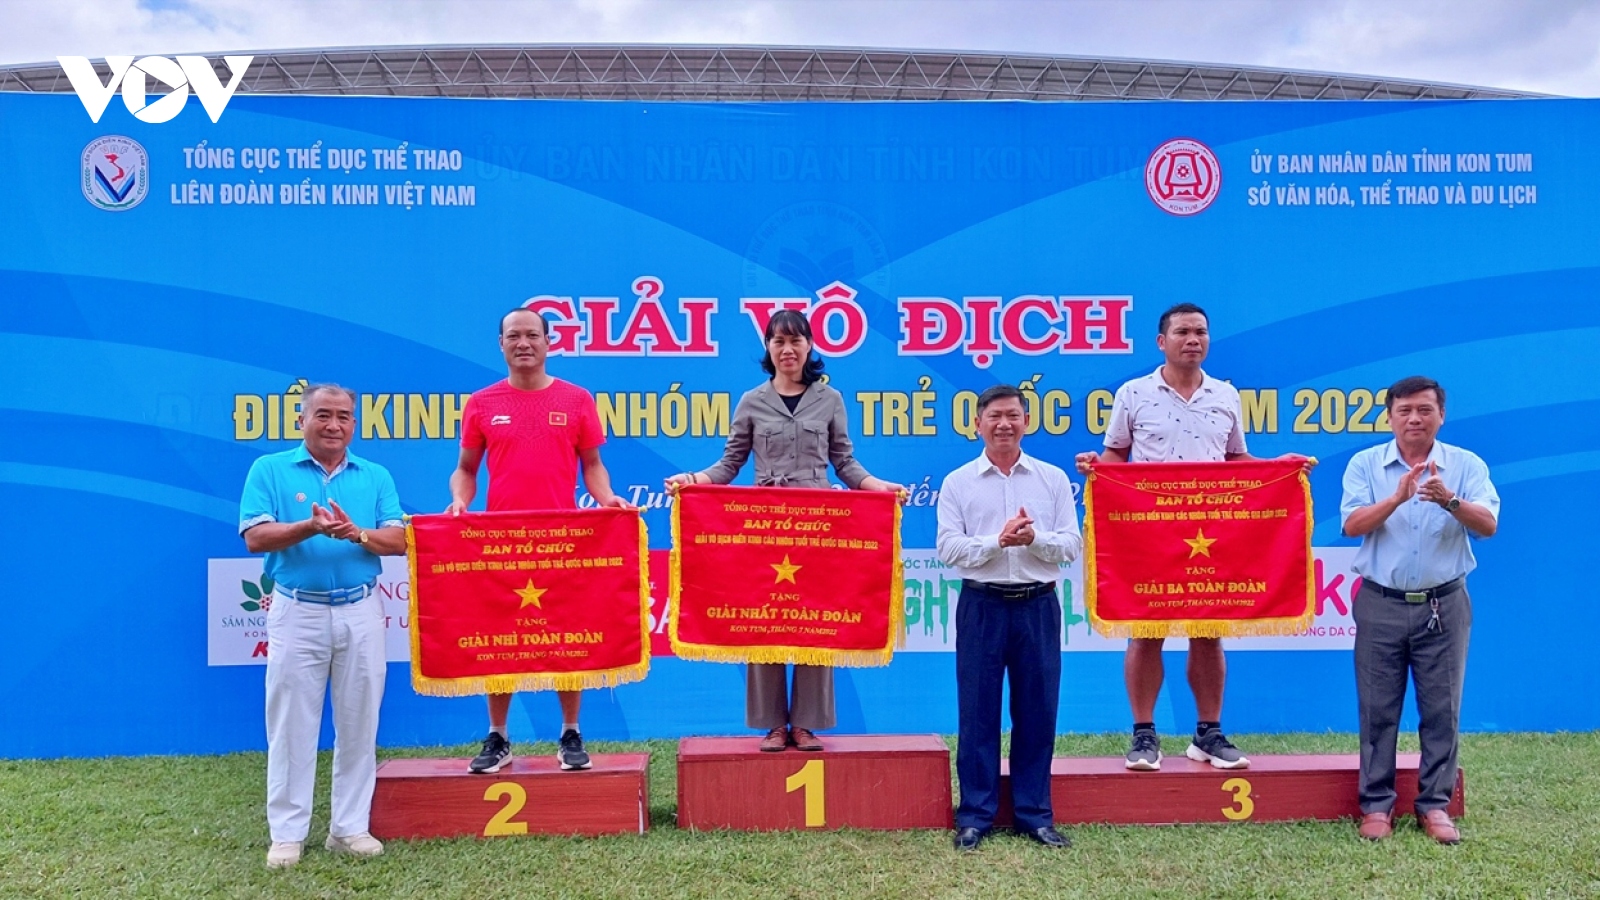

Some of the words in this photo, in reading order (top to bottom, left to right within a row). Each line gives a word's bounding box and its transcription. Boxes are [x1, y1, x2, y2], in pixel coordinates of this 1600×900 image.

[183, 139, 235, 169] TỔNG
[241, 148, 281, 173] CỤC
[286, 140, 322, 169] THỂ
[327, 148, 366, 174] DỤC
[372, 141, 408, 170] THỂ
[413, 149, 462, 171] THAO
[1250, 149, 1273, 173] ỦY
[1278, 154, 1313, 173] BAN
[1319, 151, 1367, 173] NHÂN
[1372, 150, 1407, 173] DÂN
[1412, 147, 1451, 173] TỈNH
[1456, 153, 1491, 172] KON
[1495, 153, 1532, 172] TUM
[171, 179, 214, 204] LIÊN
[220, 179, 274, 204] ĐOÀN
[280, 177, 326, 205] ĐIỀN
[332, 184, 379, 205] KINH
[384, 181, 425, 210] VIỆT
[431, 185, 476, 206] NAM
[1248, 180, 1271, 206] SỞ
[1275, 183, 1310, 205] VĂN
[1315, 183, 1355, 208] HÓA,
[1360, 179, 1391, 205] THỂ
[1396, 186, 1439, 205] THAO
[1444, 182, 1467, 205] VÀ
[1471, 186, 1494, 204] DU
[1499, 185, 1537, 208] LỊCH
[521, 275, 719, 357] GIẢI
[897, 295, 1133, 369] ĐỊCH
[232, 378, 303, 441] ĐIỀ
[360, 393, 472, 441] KINH
[595, 382, 730, 438] NHÓM
[856, 376, 937, 436] TRẺ
[952, 374, 1071, 441] QỐC
[1292, 388, 1393, 434] 2022
[1237, 480, 1262, 488] THAO
[1156, 496, 1183, 506] BAN
[1206, 493, 1244, 505] CHỨC
[826, 508, 852, 517] THAO
[569, 528, 594, 536] THAO
[743, 519, 772, 529] BAN
[794, 520, 831, 532] CHỨC
[483, 544, 512, 554] BAN
[536, 542, 575, 553] CHỨC
[1134, 580, 1164, 594] GIẢI
[1167, 583, 1184, 594] BA
[1187, 579, 1225, 593] TOÀN
[1228, 579, 1266, 593] ĐOÀN
[707, 604, 736, 619] GIẢI
[740, 603, 778, 620] NHẤT
[781, 607, 819, 621] TOÀN
[822, 610, 862, 623] ĐOÀN
[458, 632, 489, 648] GIẢI
[492, 630, 518, 646] NHÌ
[521, 629, 561, 645] TOÀN
[564, 629, 603, 643] ĐOÀN
[785, 759, 825, 827] 1
[1221, 778, 1254, 820] 3
[482, 781, 528, 837] 2
